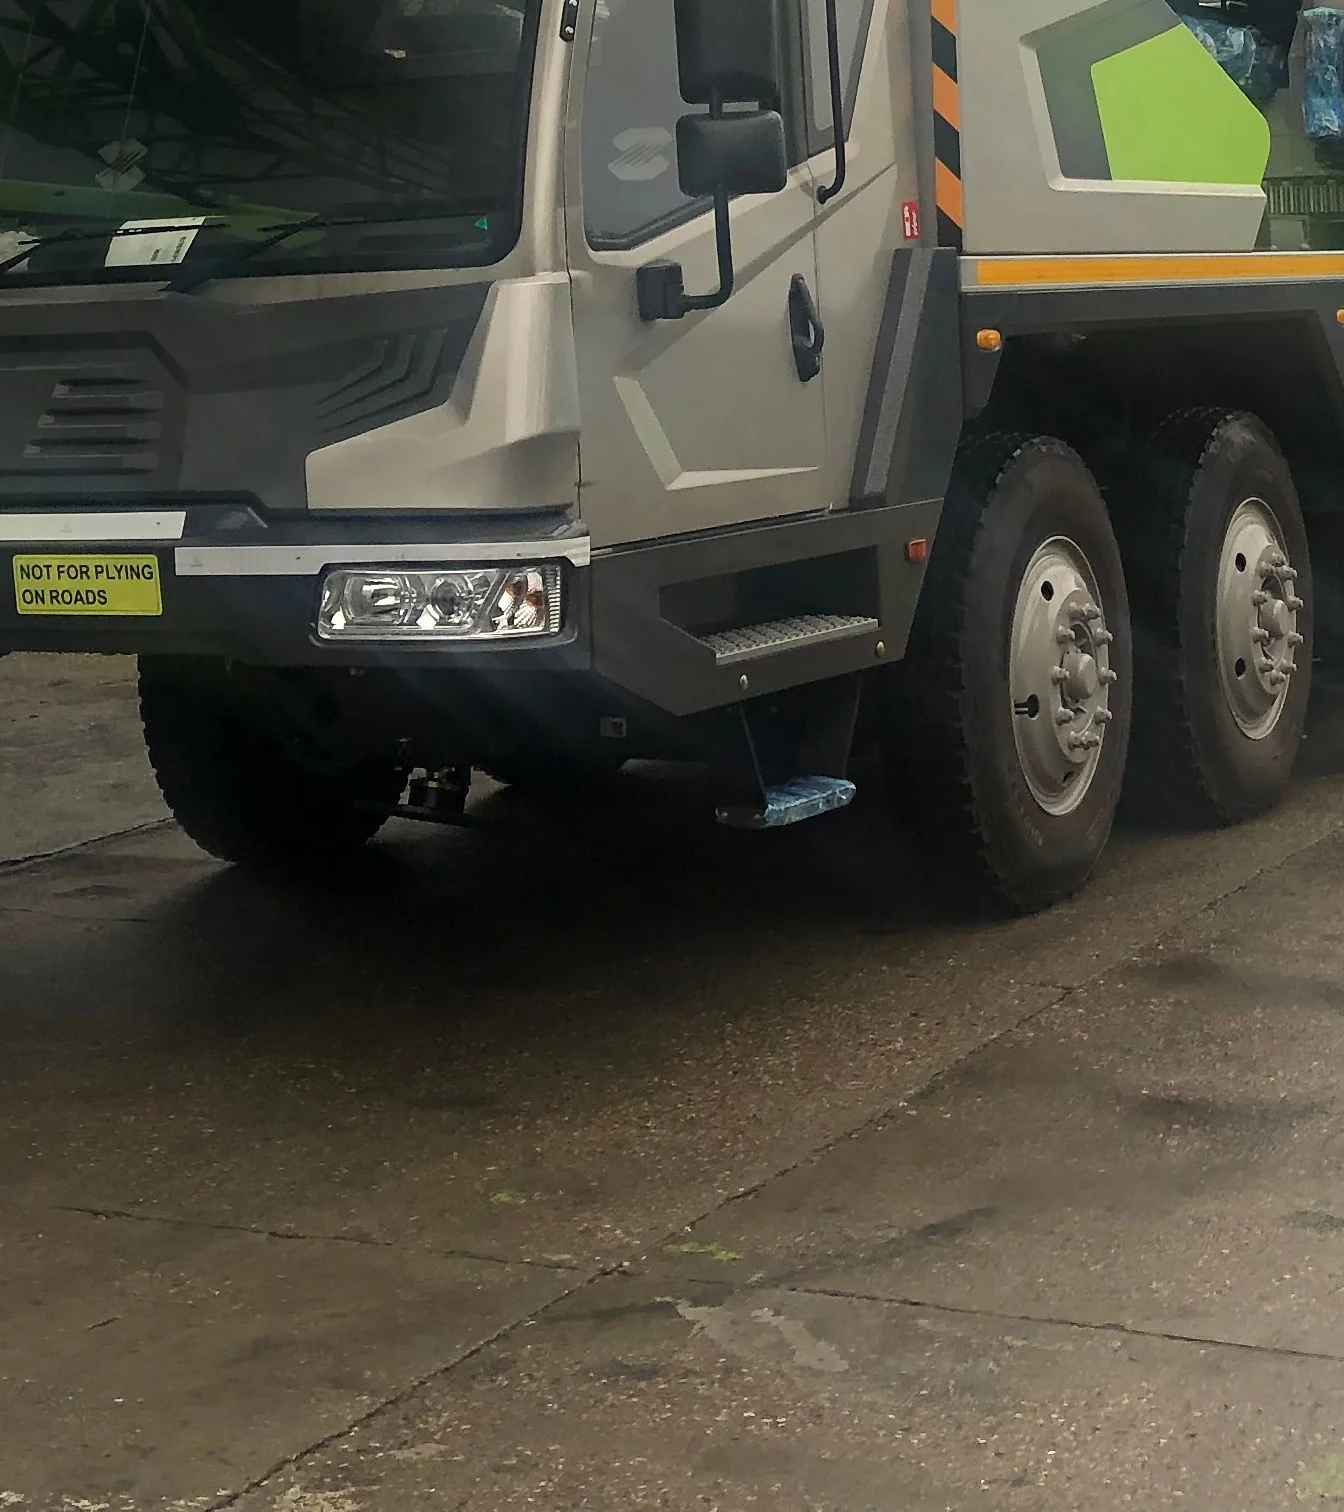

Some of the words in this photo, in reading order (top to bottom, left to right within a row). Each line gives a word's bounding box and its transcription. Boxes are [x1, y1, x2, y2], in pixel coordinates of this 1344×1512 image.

[20, 564, 52, 580] NOT
[57, 564, 90, 580] FOR
[95, 564, 154, 581] PLYING
[22, 589, 45, 604] ON
[49, 589, 108, 605] ROADS
